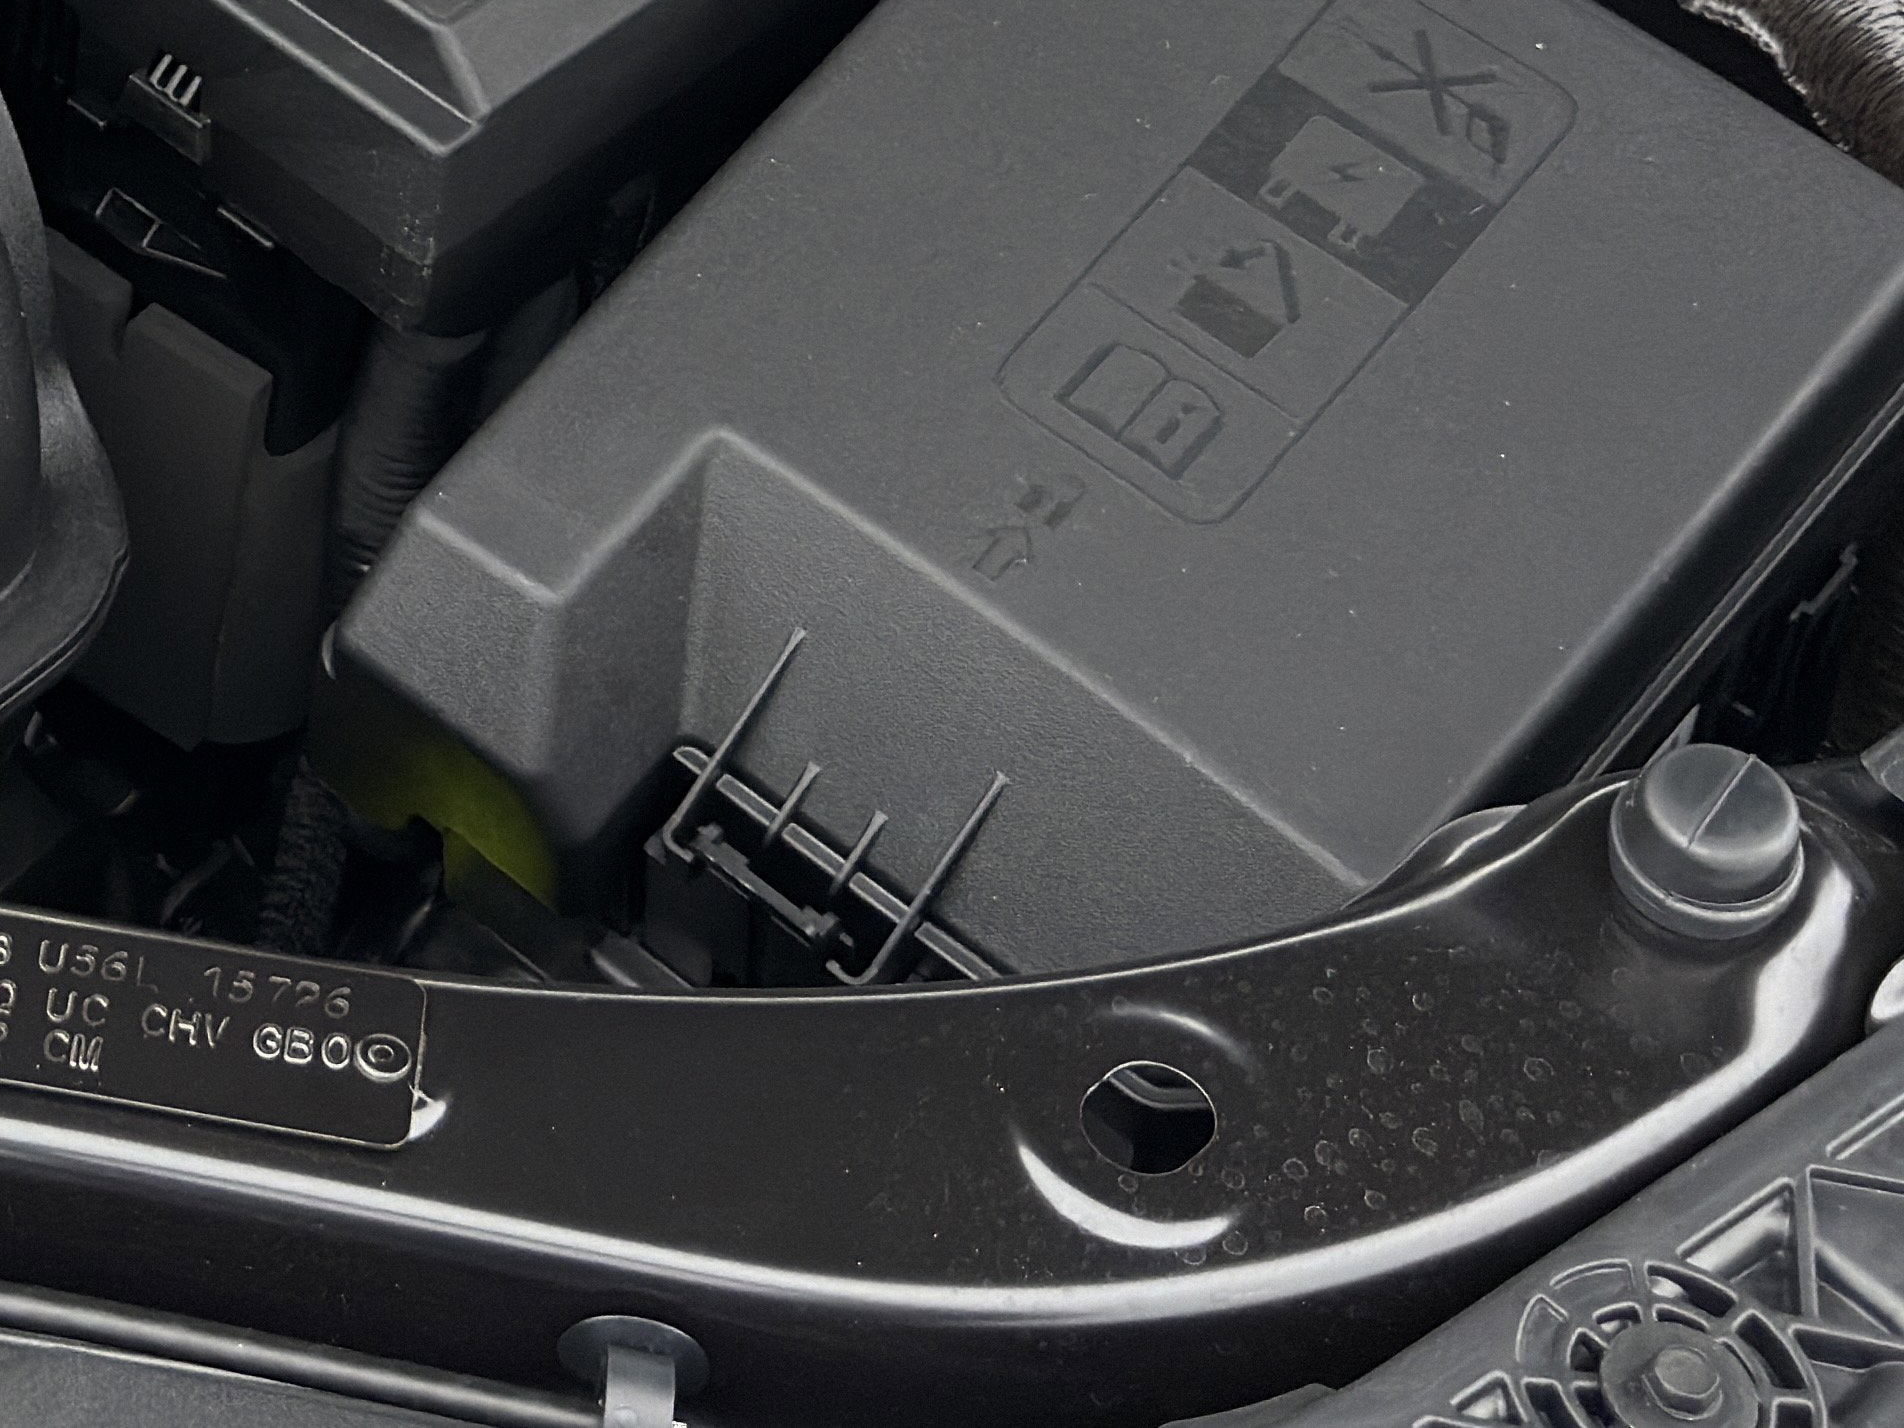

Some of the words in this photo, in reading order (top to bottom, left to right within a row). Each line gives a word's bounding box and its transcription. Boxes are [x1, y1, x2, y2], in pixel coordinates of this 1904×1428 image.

[46, 987, 111, 1027] UC
[140, 1002, 230, 1048] CHV
[43, 1028, 104, 1071] CM
